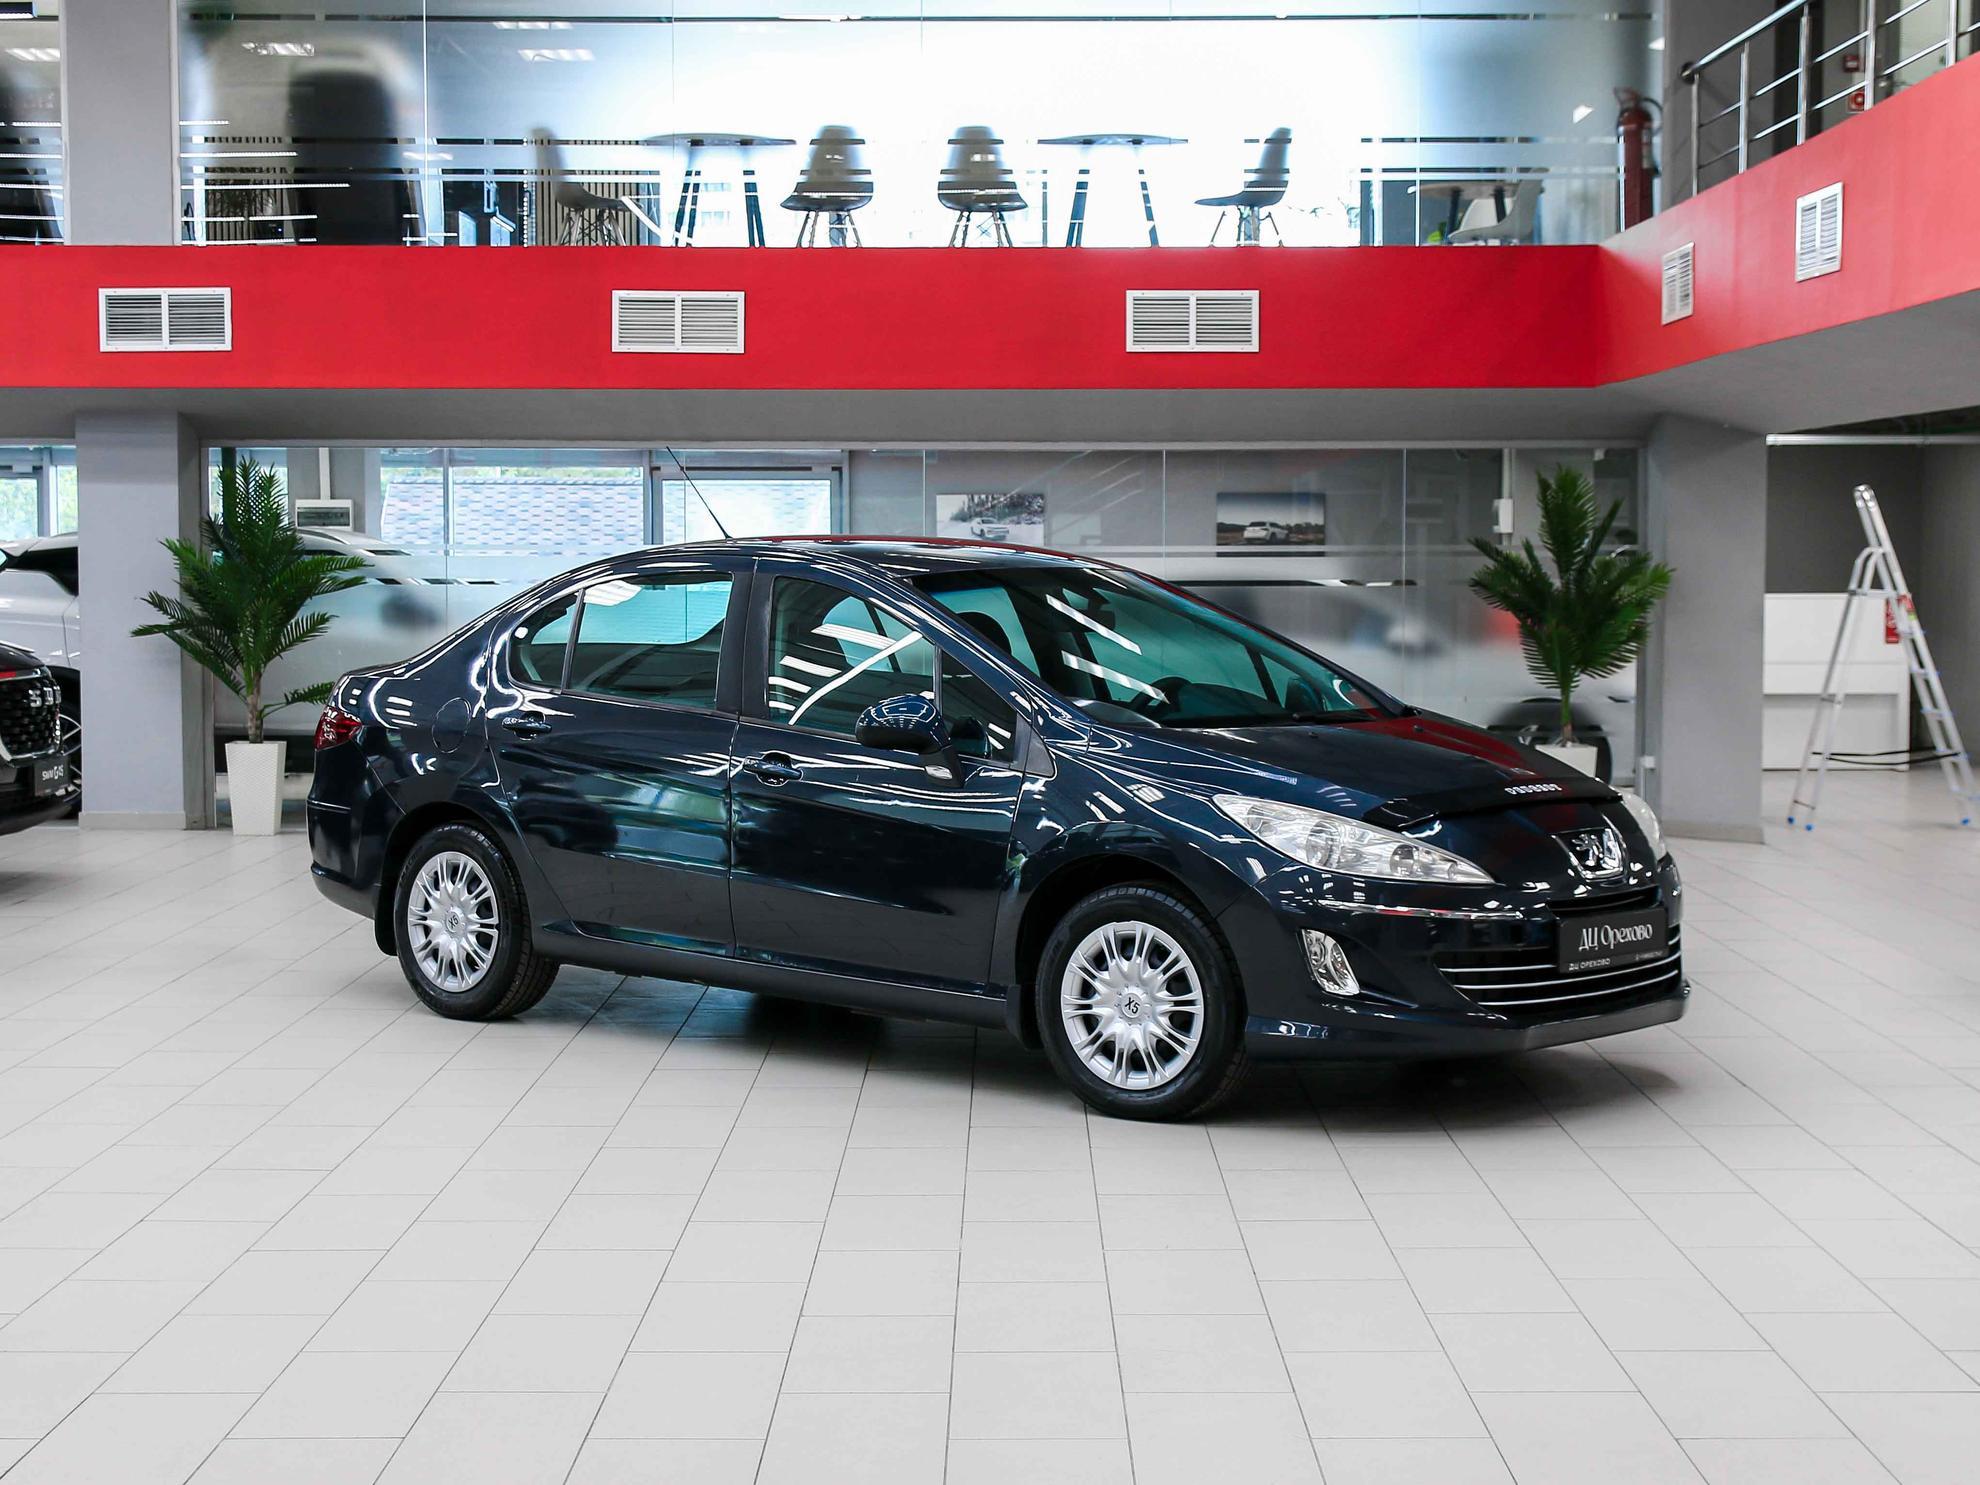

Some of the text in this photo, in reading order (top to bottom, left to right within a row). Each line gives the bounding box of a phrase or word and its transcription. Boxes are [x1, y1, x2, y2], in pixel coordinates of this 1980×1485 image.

[1578, 924, 1653, 951] ДЦ Орехово
[1125, 997, 1140, 1014] X5
